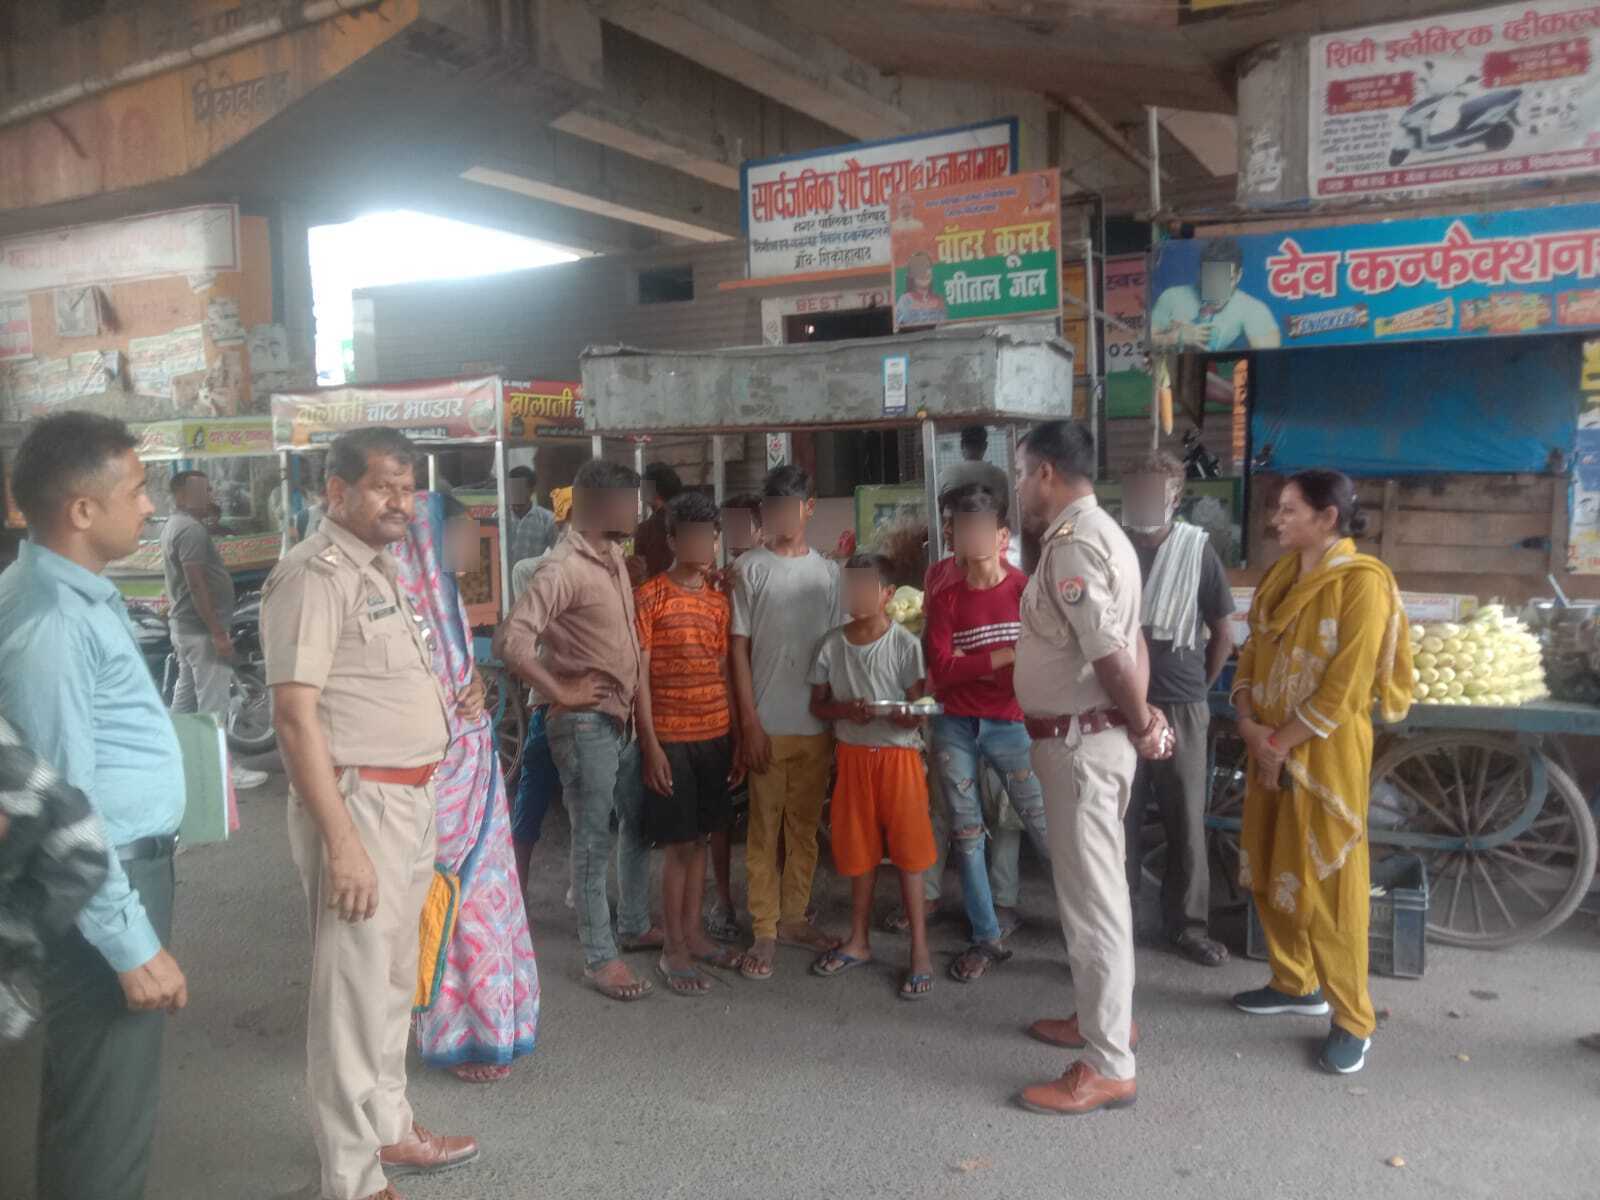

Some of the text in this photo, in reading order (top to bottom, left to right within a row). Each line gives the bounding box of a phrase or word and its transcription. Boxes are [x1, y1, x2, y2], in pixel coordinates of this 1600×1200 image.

[751, 168, 835, 223] सार्वजनिक
[837, 157, 913, 210] शौचालय
[991, 221, 1051, 269] कूलर
[943, 268, 1048, 305] शीतल जल
[1267, 238, 1340, 299] देव
[366, 400, 400, 423] चाट
[403, 397, 464, 420] भण्डार
[509, 387, 574, 418] बालाजी
